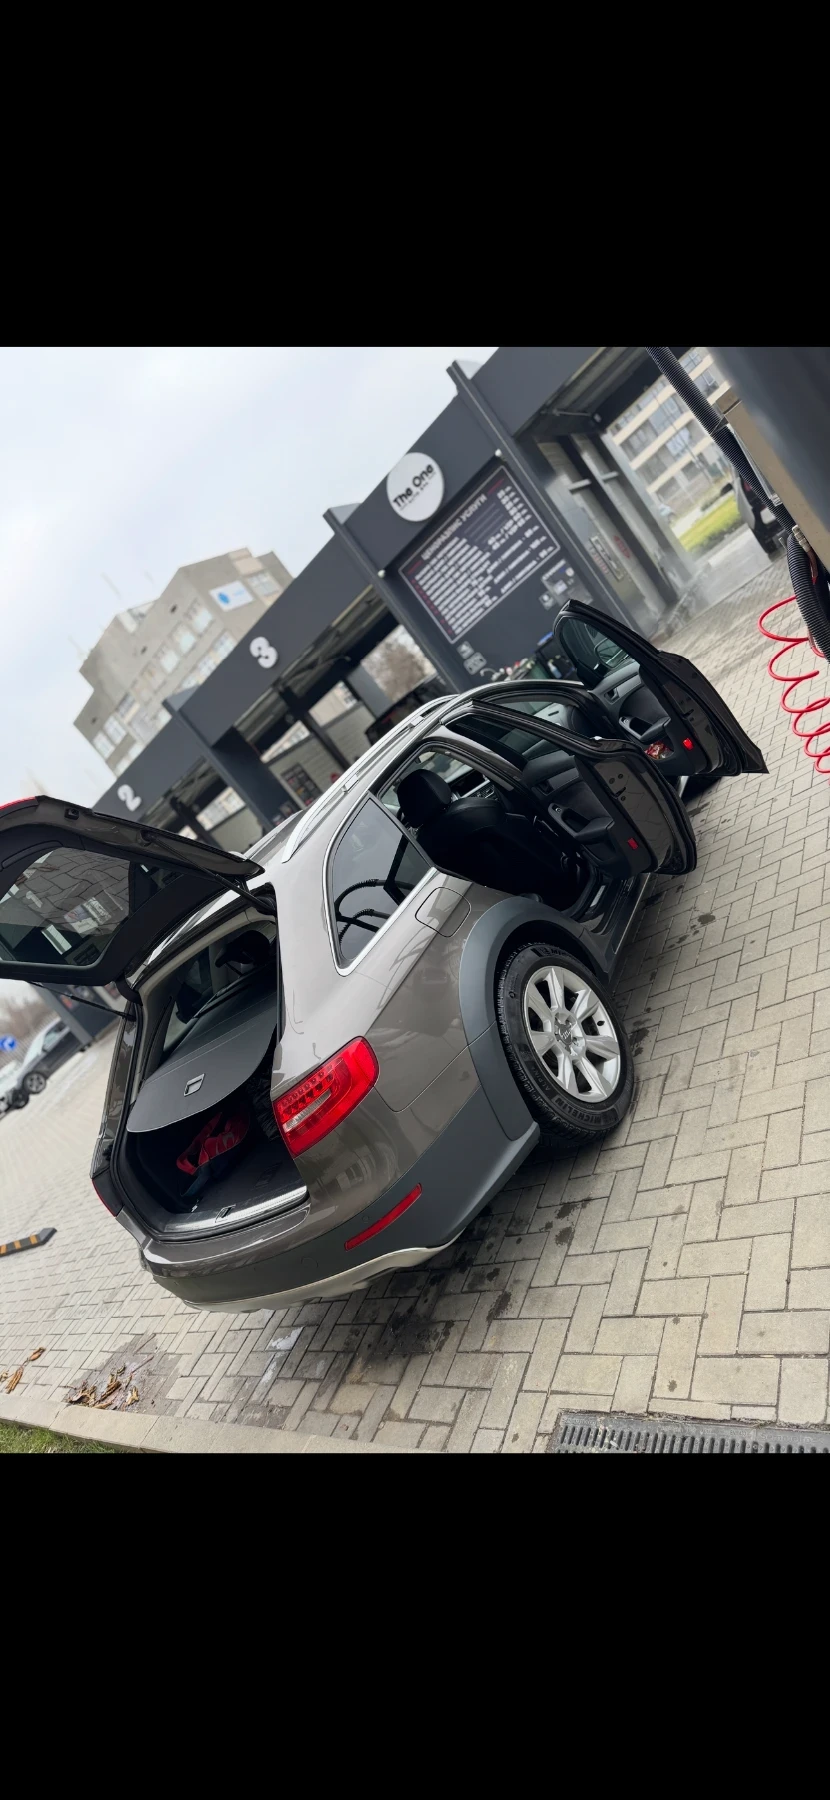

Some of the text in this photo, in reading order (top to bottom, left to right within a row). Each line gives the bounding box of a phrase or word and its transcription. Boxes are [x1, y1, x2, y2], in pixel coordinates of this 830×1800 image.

[393, 488, 413, 507] The
[412, 464, 434, 487] One
[250, 636, 278, 669] 3
[117, 784, 141, 812] 2
[555, 1098, 600, 1123] MICHELIN
